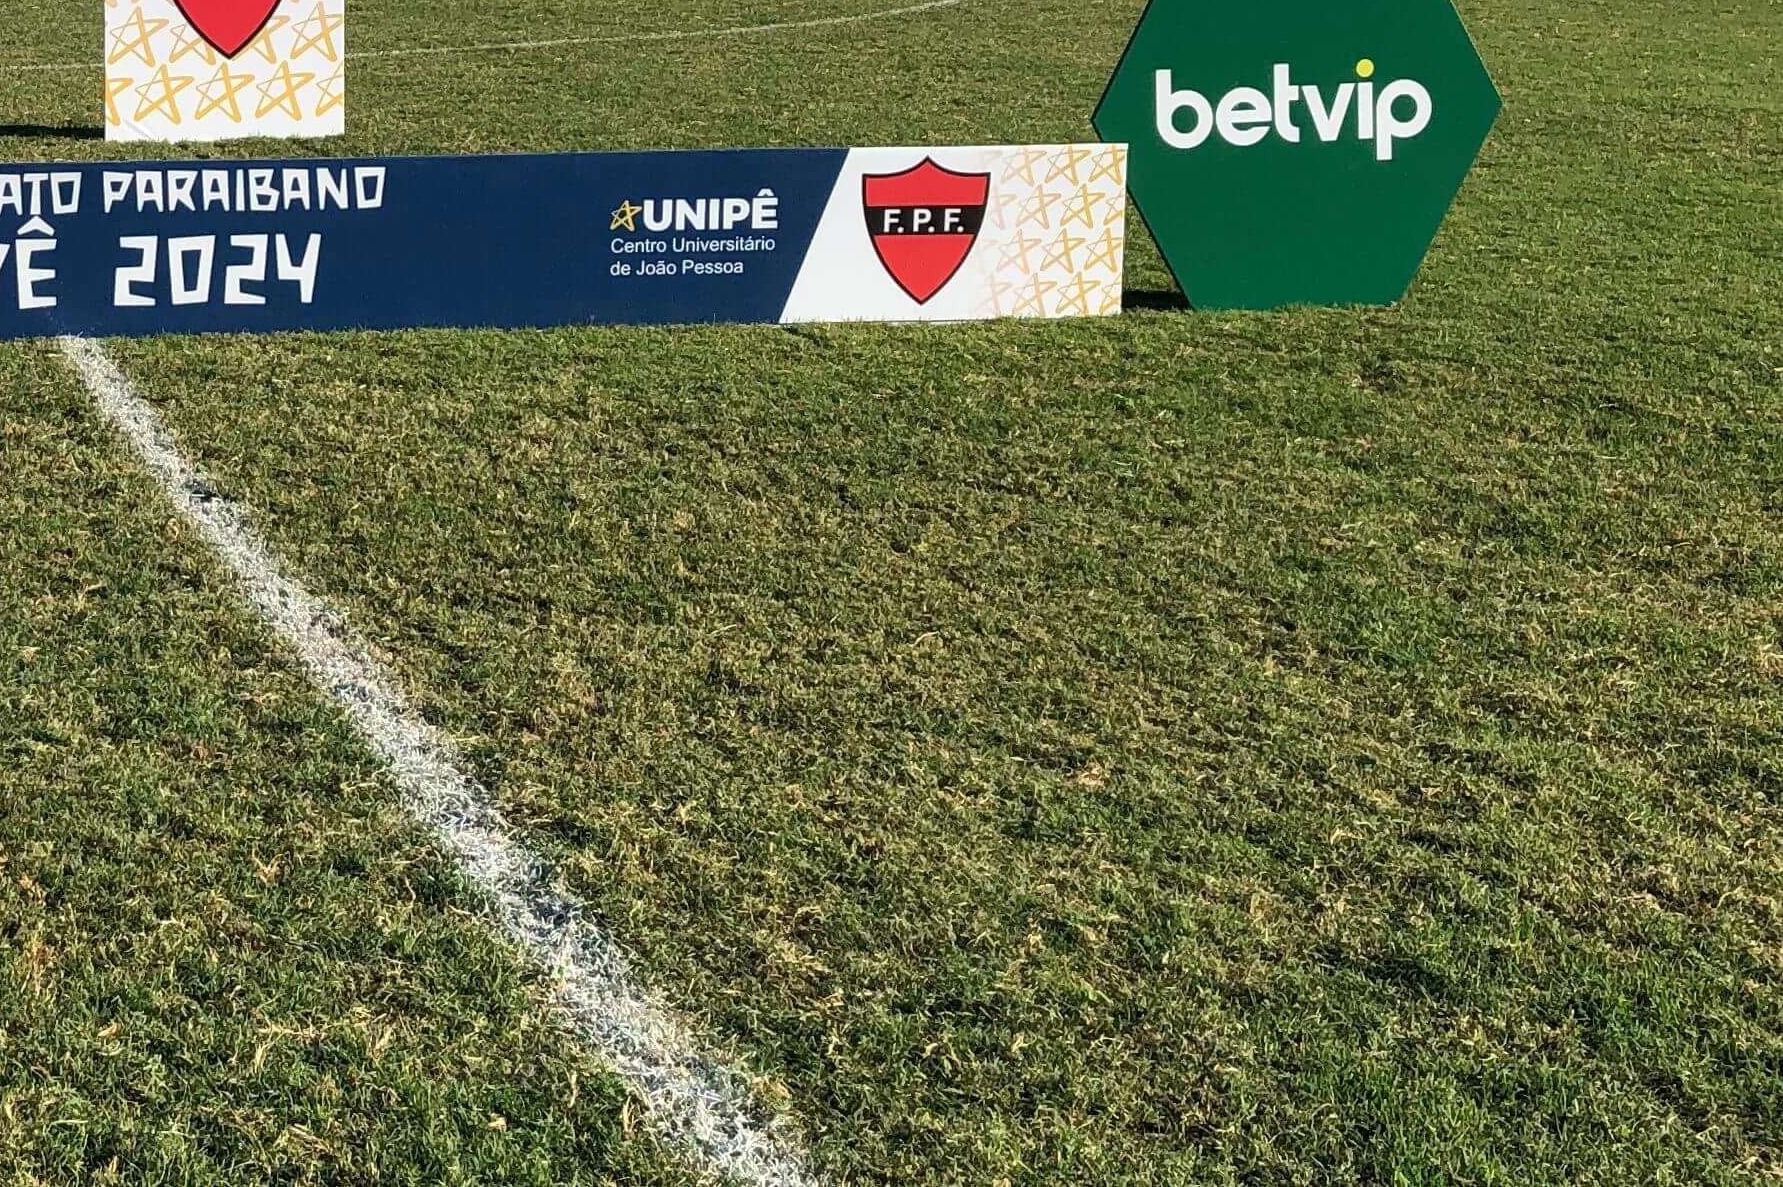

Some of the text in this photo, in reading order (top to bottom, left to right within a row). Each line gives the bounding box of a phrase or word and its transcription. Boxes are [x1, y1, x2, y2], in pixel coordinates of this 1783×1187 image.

[1155, 58, 1433, 161] betvip
[103, 166, 386, 213] PARAIBANO
[642, 187, 779, 232] UNIPÊ
[610, 235, 776, 254] Centro Universitário
[114, 233, 321, 307] 2024
[610, 259, 744, 277] de João Pessoa
